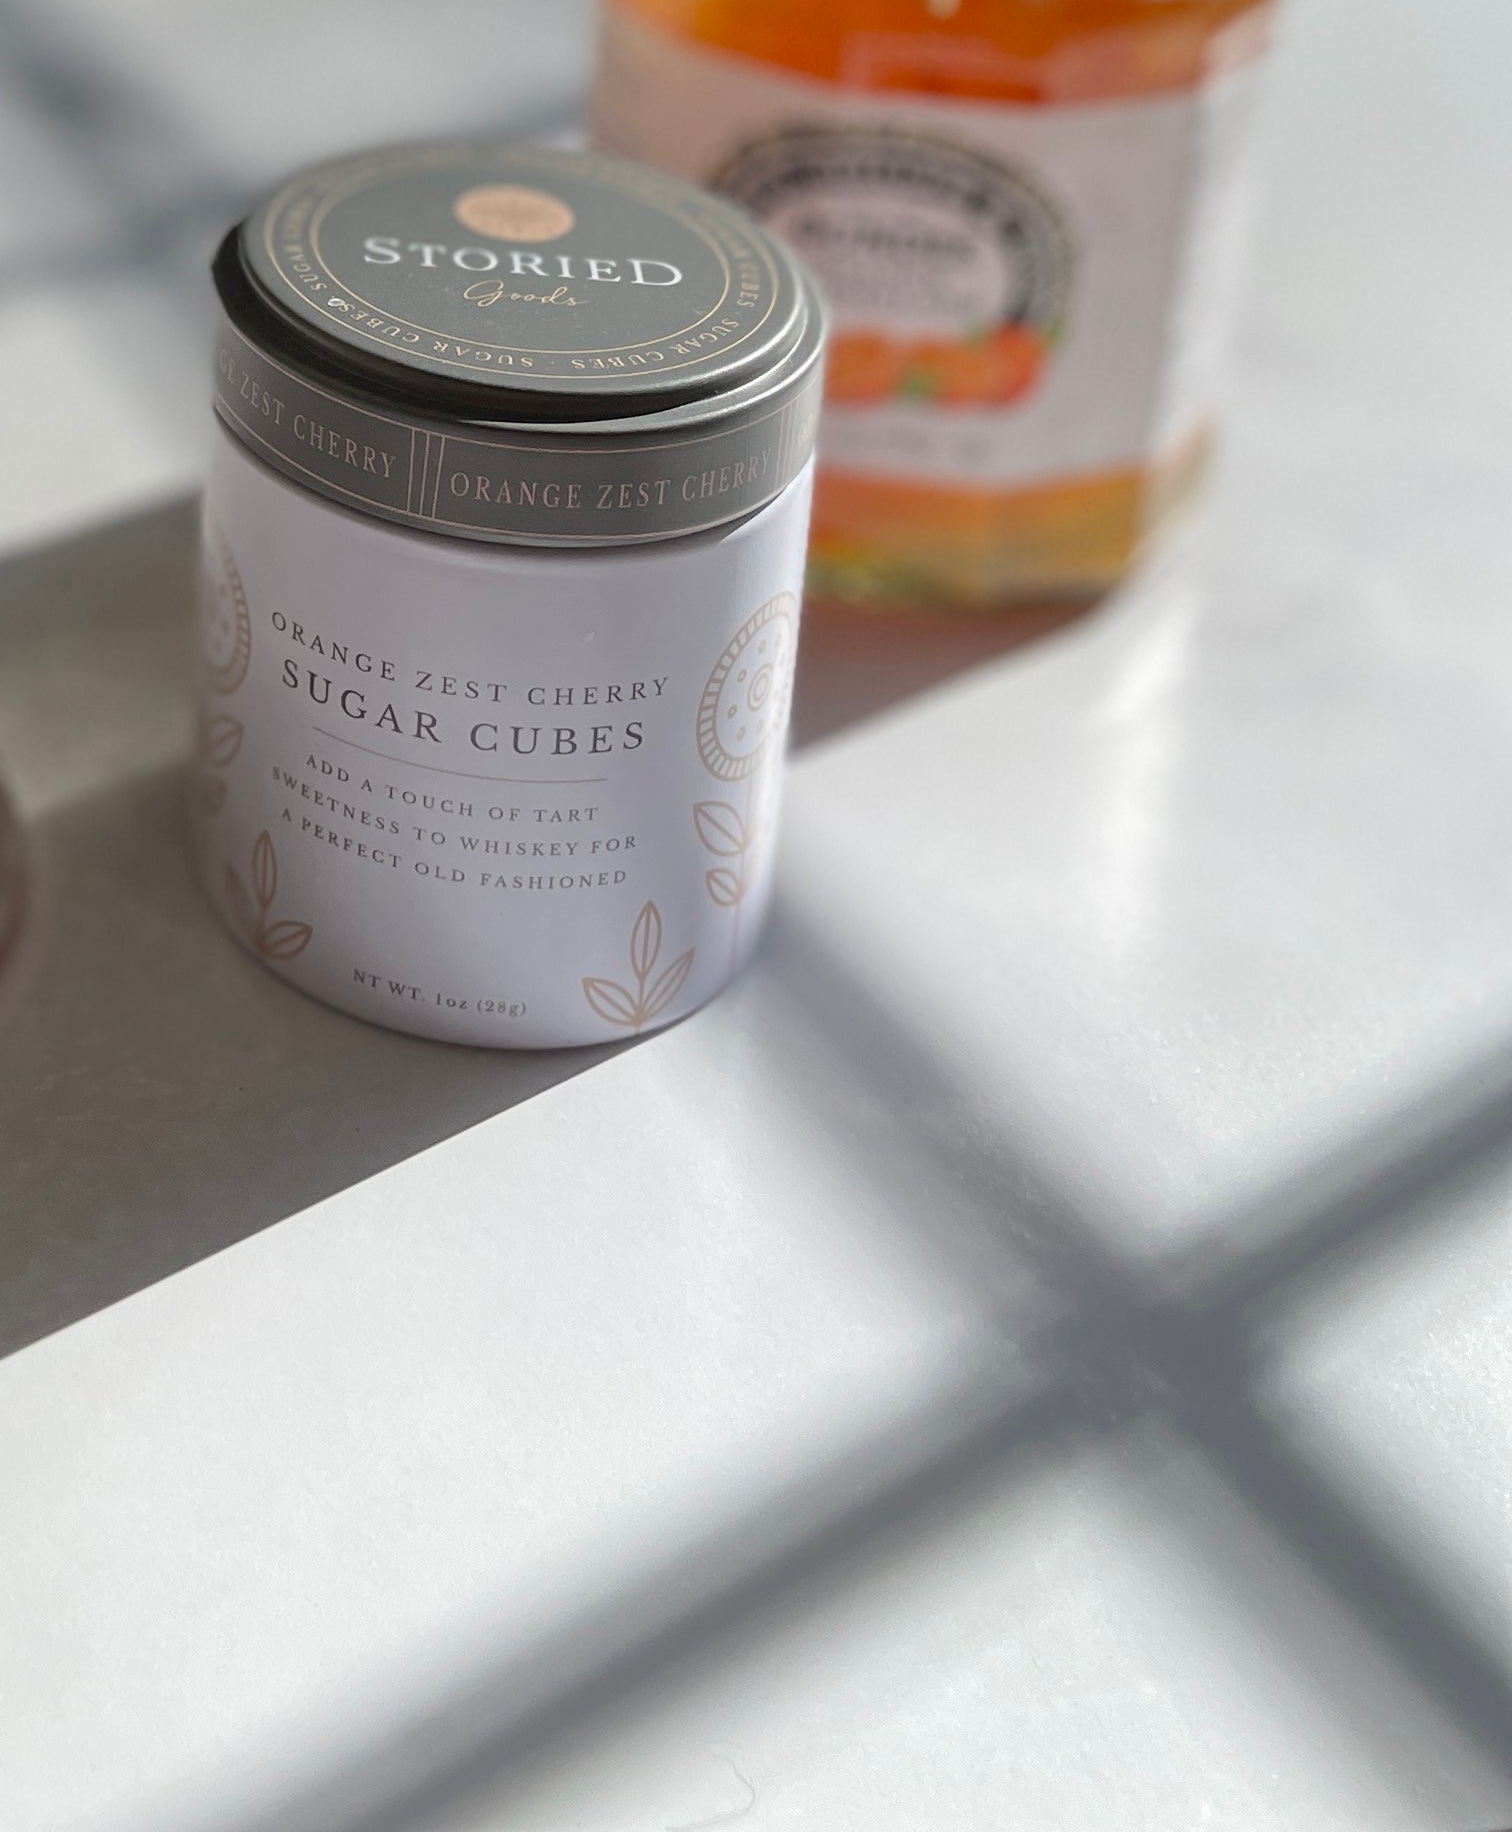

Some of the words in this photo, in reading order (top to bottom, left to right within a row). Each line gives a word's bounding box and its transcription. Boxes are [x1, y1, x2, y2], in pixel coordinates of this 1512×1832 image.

[363, 235, 683, 287] STORIED
[463, 279, 588, 308] Goods
[337, 302, 420, 344] CUBES
[669, 317, 739, 355] SUGAR
[433, 340, 534, 369] SUGAR
[571, 350, 665, 370] CUBES
[240, 371, 285, 426] ZEST
[293, 414, 397, 479] CHERRY
[450, 472, 582, 510] ORANGE
[596, 478, 672, 510] ZEST
[681, 447, 774, 503] CHERRY
[271, 611, 396, 682] ORANGE
[414, 670, 508, 703] ZEST
[526, 676, 669, 707] CHERRY
[282, 658, 443, 744] SUGAR
[469, 721, 645, 756] CUBES
[272, 766, 401, 835] SWEETNESS
[411, 826, 447, 846] TO
[459, 835, 580, 857] WHISKEY
[590, 835, 637, 855] FOR
[306, 754, 350, 782] ADD
[360, 778, 373, 793] A
[384, 784, 474, 818] TOUCH
[487, 806, 522, 822] OF
[532, 807, 600, 823] TART
[281, 807, 292, 823] A
[301, 817, 402, 869] PERFECT
[414, 861, 466, 883] OLD
[479, 870, 627, 890] FASHIONED
[353, 968, 381, 989] NT
[388, 980, 427, 1002] WT.
[477, 999, 528, 1018] (28g)
